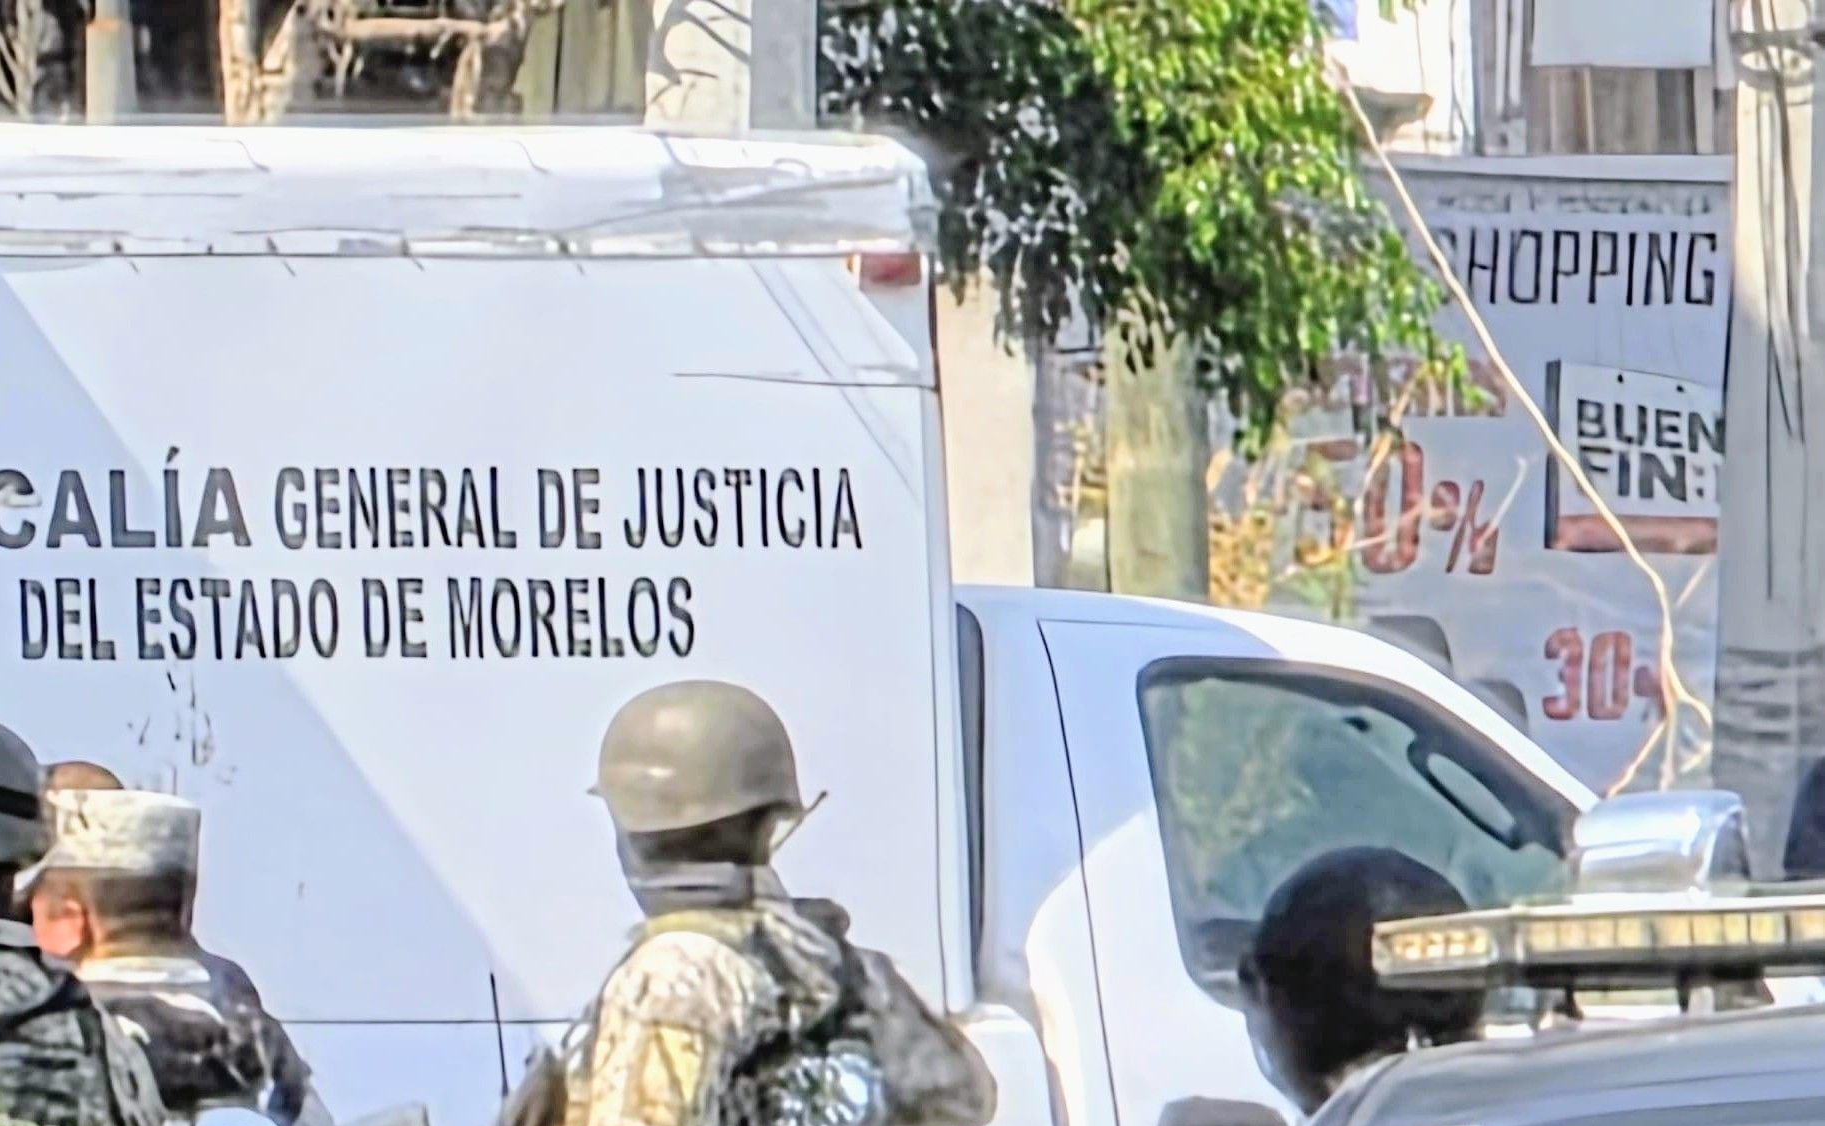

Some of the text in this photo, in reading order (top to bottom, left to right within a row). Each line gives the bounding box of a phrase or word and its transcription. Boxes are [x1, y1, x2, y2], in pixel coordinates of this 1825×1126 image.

[1577, 398, 1726, 455] BUEN
[275, 467, 517, 550] GENERAL
[538, 468, 602, 549] DE
[624, 467, 863, 549] JUSTICIA
[19, 576, 695, 661] DEL ESTADO DE MORELOS
